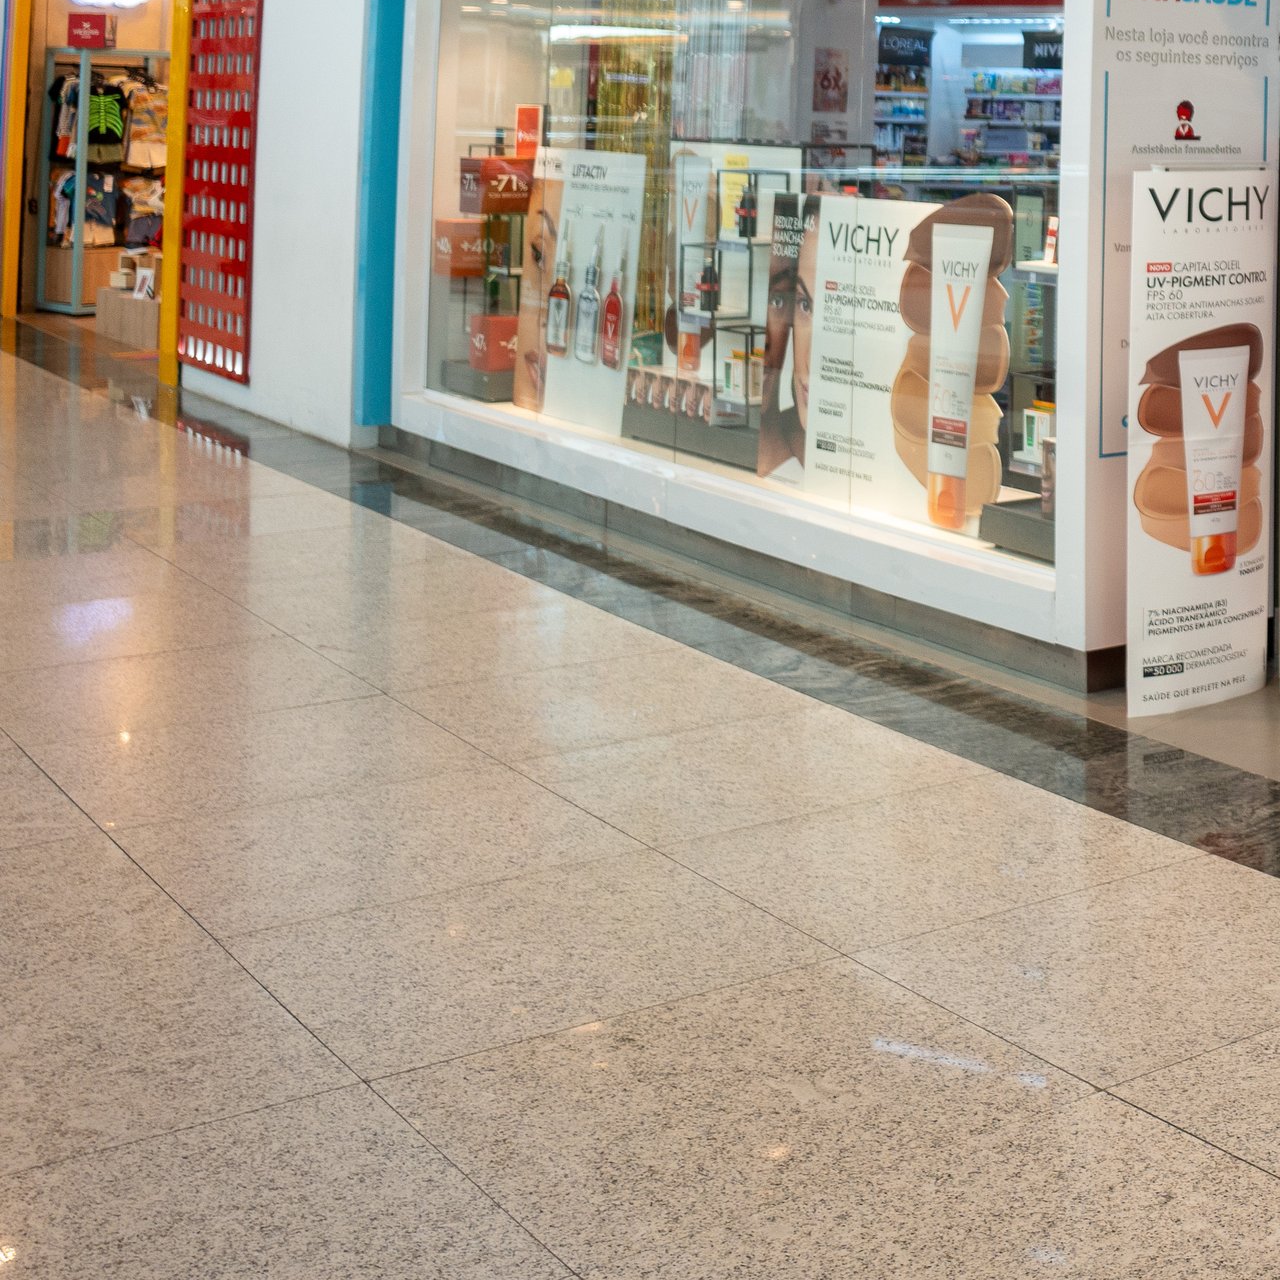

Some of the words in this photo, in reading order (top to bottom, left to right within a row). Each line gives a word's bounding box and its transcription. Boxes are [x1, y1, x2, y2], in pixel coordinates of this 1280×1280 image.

[1105, 26, 1146, 42] Nesta
[1150, 27, 1175, 48] loja
[1178, 30, 1209, 46] você
[1212, 33, 1270, 49] encontra
[1116, 51, 1132, 62] os
[1135, 50, 1202, 67] seguintes
[1204, 52, 1259, 71] serviços
[1131, 144, 1183, 155] Assistência
[1148, 185, 1270, 223] VICHY
[828, 221, 900, 257] VICHY
[942, 259, 980, 279] VICHY
[1149, 263, 1171, 272] NOVO
[1173, 261, 1212, 273] CAPITAL
[1214, 259, 1241, 272] SOLEIL
[1146, 274, 1227, 289] UV-PIGMENT
[1228, 270, 1268, 286] CONTROL
[1146, 290, 1166, 301] FPS
[1168, 289, 1184, 301] 60
[1146, 301, 1187, 311] PROTETOR
[1188, 297, 1243, 310] ANTIMANCHAS
[1146, 312, 1166, 321] ALTA
[1194, 373, 1239, 389] VICHY
[1161, 602, 1214, 617] NIACINAMIDA
[1148, 623, 1194, 637] PIGMENTOS
[1195, 622, 1206, 631] EM
[1206, 619, 1222, 629] ALTA
[1142, 655, 1175, 666] MARCA
[1175, 643, 1233, 662] RECOMENDADA
[1173, 687, 1190, 698] QUE
[1192, 682, 1220, 695] REFLETE
